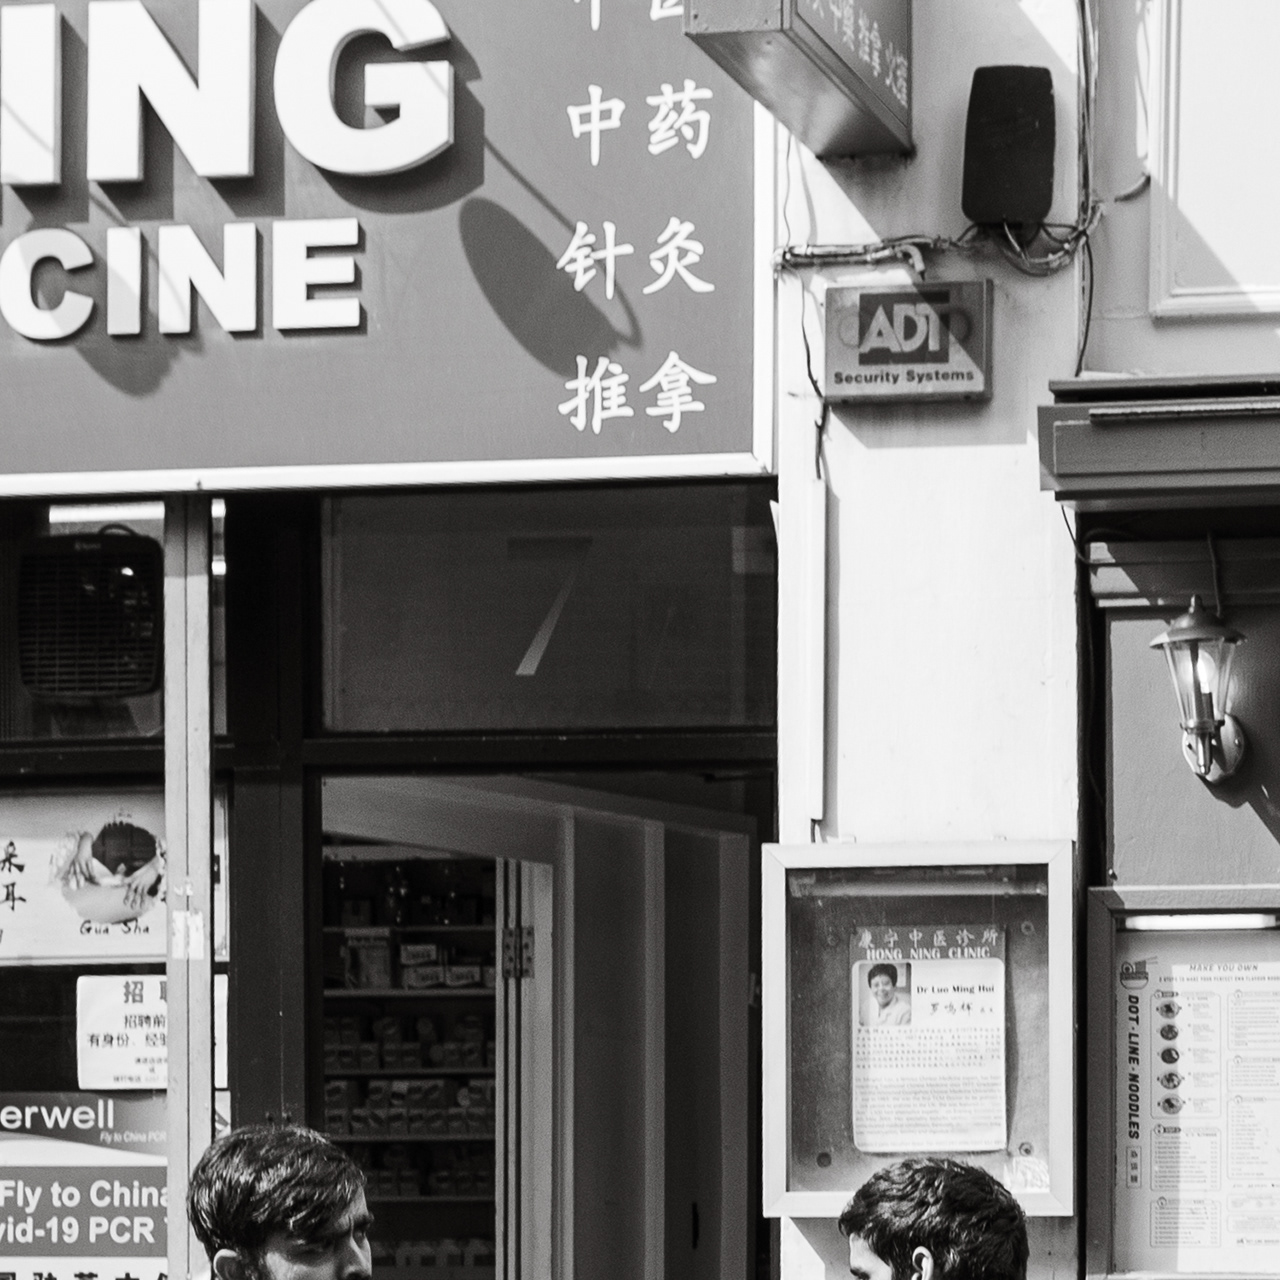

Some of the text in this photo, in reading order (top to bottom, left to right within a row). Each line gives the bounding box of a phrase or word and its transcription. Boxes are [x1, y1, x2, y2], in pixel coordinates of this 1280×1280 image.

[566, 78, 713, 166] 中药
[556, 216, 716, 300] 针灸
[859, 302, 942, 353] ADT
[557, 350, 717, 434] 推拿
[833, 369, 975, 385] Security Systems
[79, 918, 150, 936] Gua Sha
[866, 945, 991, 961] HONG NING CLINIC
[1128, 994, 1140, 1140] DOT LINE NOODLES
[51, 1180, 81, 1208] to
[88, 1215, 156, 1244] PCR
